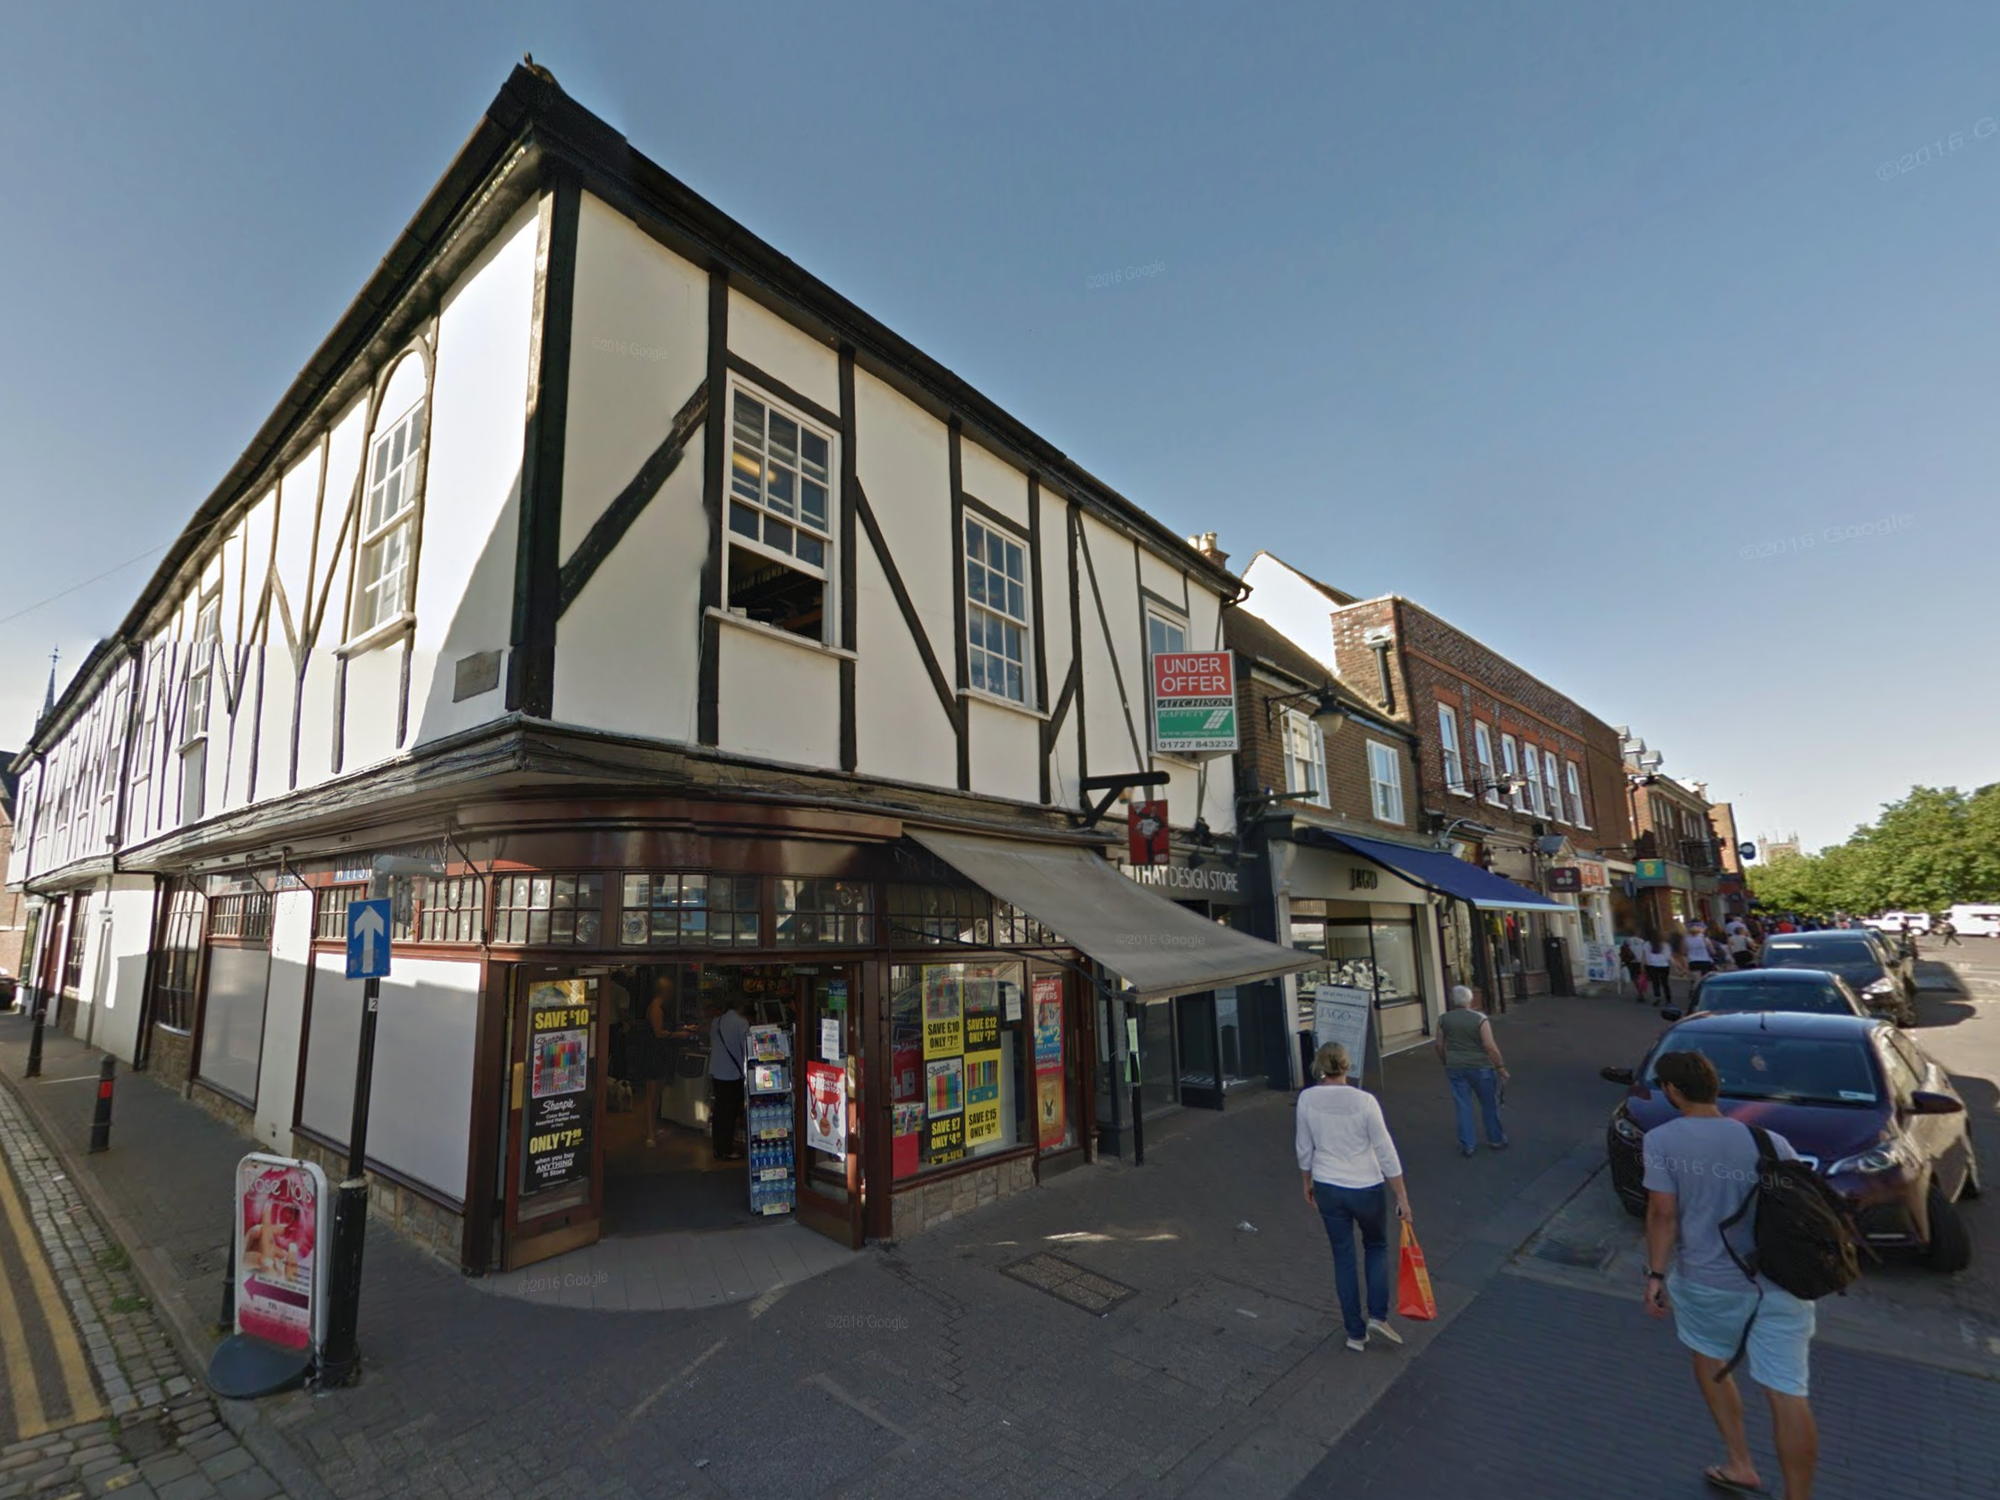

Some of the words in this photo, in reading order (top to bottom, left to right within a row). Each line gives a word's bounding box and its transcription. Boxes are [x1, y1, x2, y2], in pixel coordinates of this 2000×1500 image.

[1163, 657, 1222, 674] UNDER
[1161, 675, 1226, 692] OFFER
[1159, 698, 1230, 708] AITCHISON
[1160, 710, 1207, 718] RAFFETY
[1160, 740, 1192, 749] 01727
[1195, 740, 1235, 749] 843232
[1169, 866, 1208, 890] DESIGN
[1210, 870, 1239, 893] STORE
[535, 1010, 568, 1030] SAVE
[570, 1008, 589, 1026] £10
[967, 1017, 984, 1032] SAVE
[985, 1016, 997, 1030] £12
[928, 1022, 946, 1036] SAVE
[947, 1020, 960, 1034] £10
[930, 1036, 946, 1049] ONLY
[969, 1031, 984, 1044] ONLY
[540, 1098, 576, 1115] Sharpie
[968, 1111, 984, 1126] SAVE
[985, 1108, 997, 1122] £15
[931, 1119, 951, 1136] SAVE
[951, 1117, 961, 1131] £7
[970, 1125, 984, 1139] ONLY
[529, 1132, 560, 1155] ONLY
[931, 1134, 948, 1150] ONLY
[535, 1158, 573, 1174] ANYTHING
[551, 1154, 563, 1164] you
